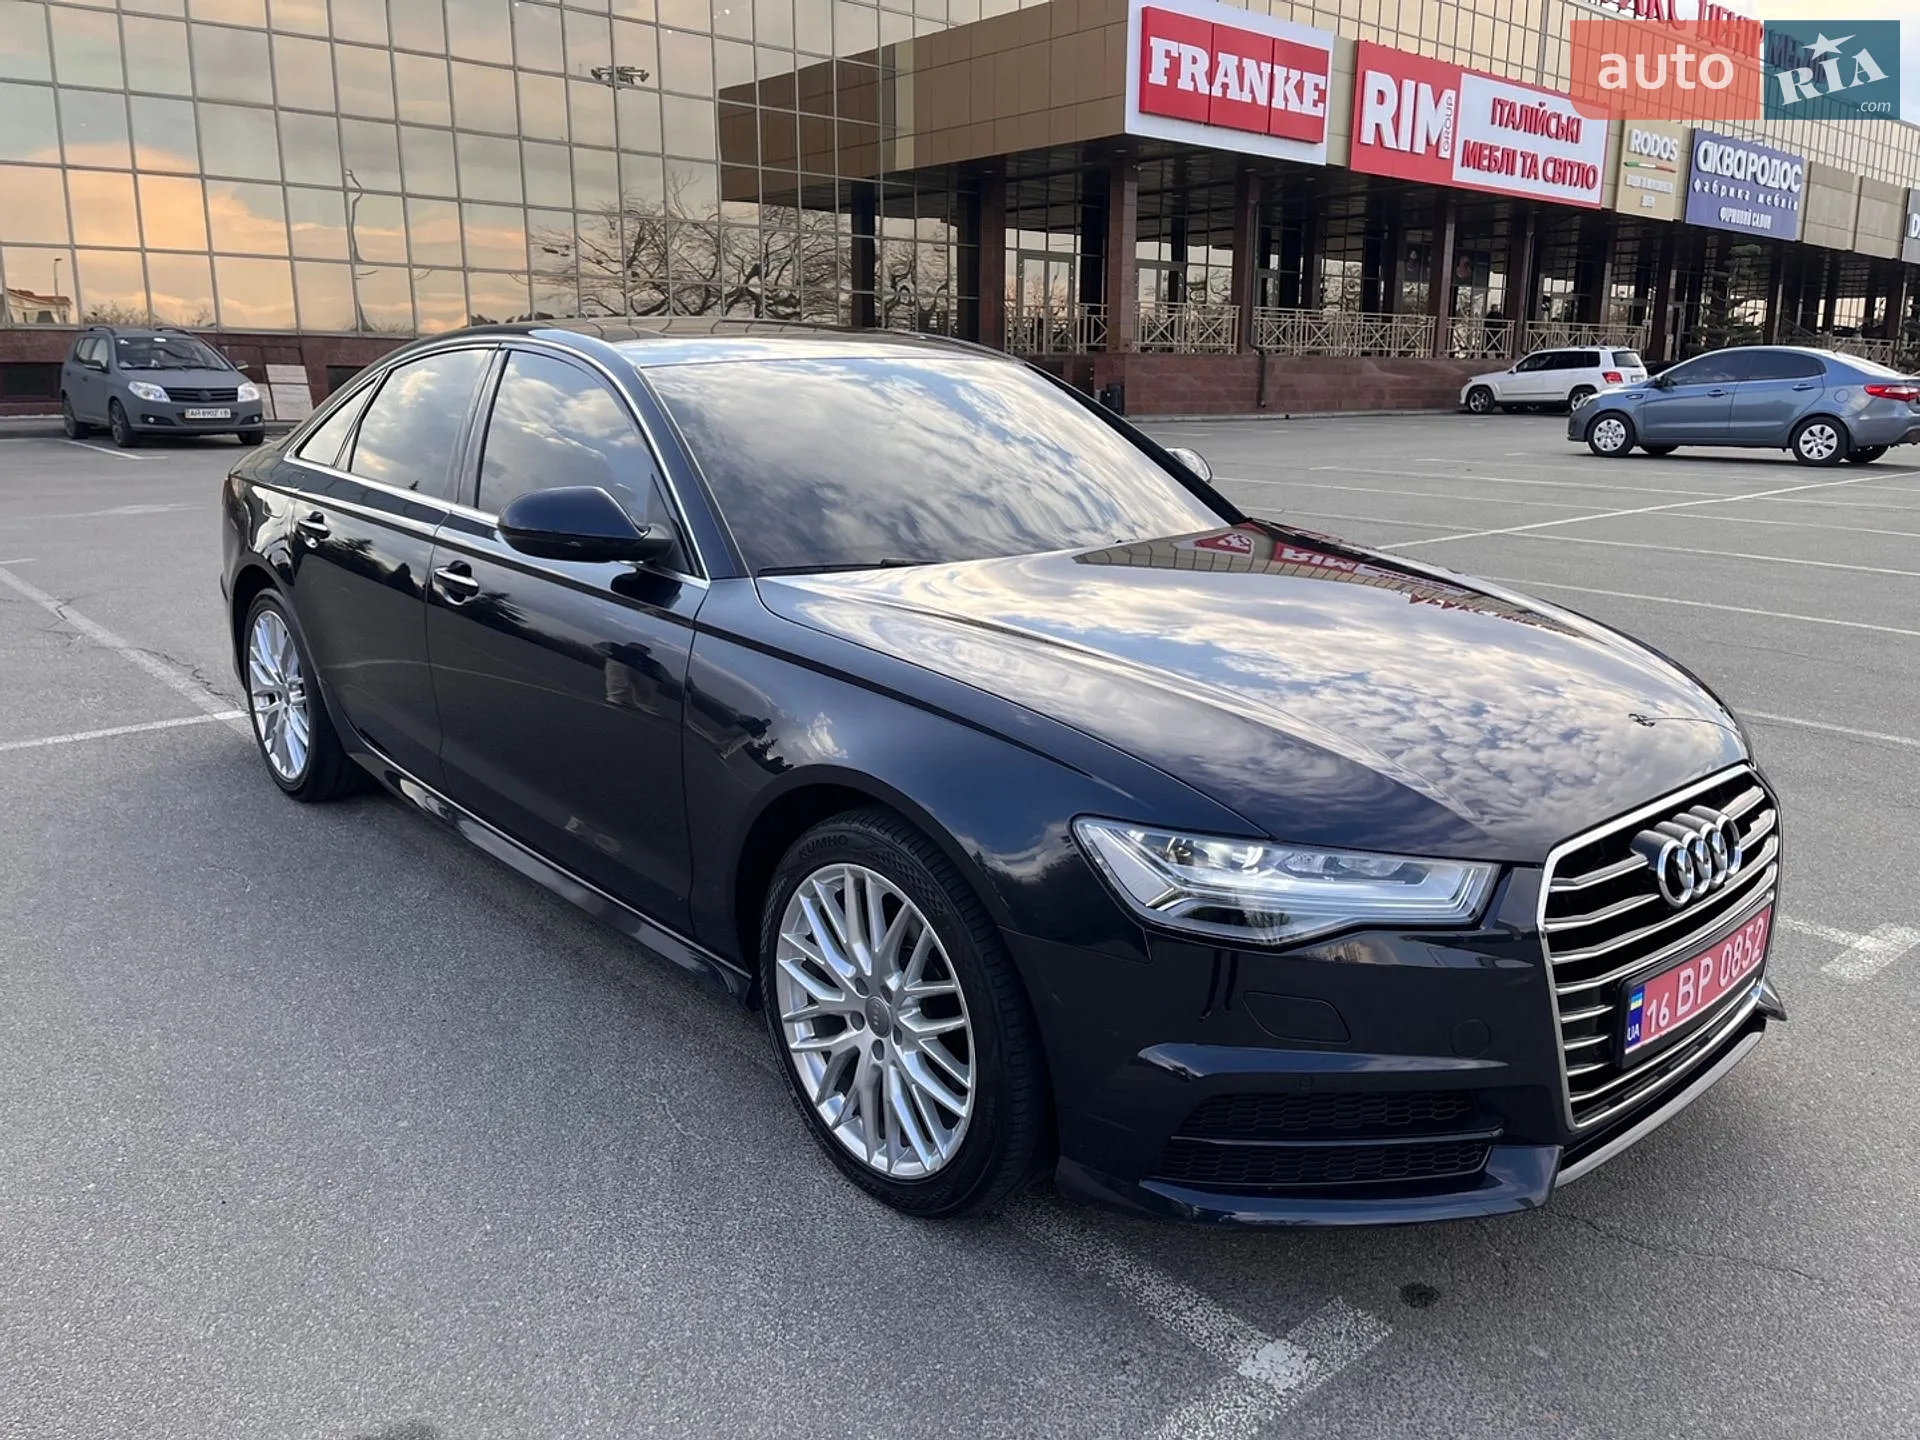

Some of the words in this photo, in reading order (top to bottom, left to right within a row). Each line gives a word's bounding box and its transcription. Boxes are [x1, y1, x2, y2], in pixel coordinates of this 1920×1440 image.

[1149, 37, 1326, 118] FRANKE
[1360, 70, 1456, 159] RIM
[1442, 95, 1454, 153] GROUP
[1461, 139, 1517, 176] МЕБЛІ
[1520, 151, 1540, 180] ТА
[1542, 156, 1599, 190] СВІТЛО
[1629, 128, 1679, 161] RODOS
[798, 834, 849, 860] KUMHO
[1646, 992, 1670, 1033] 16
[1676, 957, 1713, 1018] BP
[1719, 917, 1764, 987] 0852
[1627, 1023, 1640, 1041] UA
